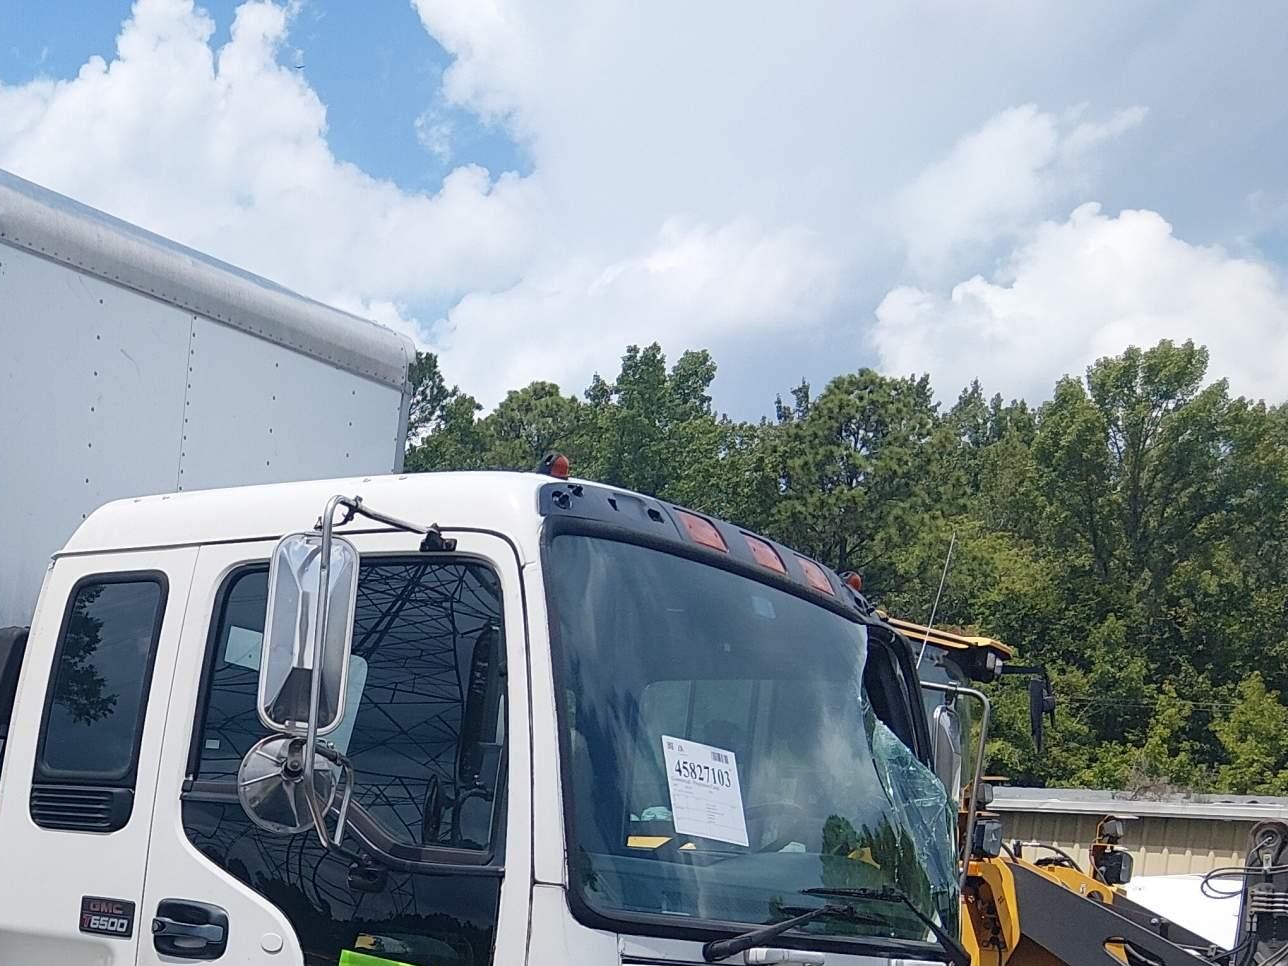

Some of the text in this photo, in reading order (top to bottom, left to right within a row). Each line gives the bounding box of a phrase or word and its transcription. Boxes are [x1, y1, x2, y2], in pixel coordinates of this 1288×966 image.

[675, 760, 731, 788] 45827103
[90, 902, 123, 914] GMC
[83, 914, 128, 932] T6500
